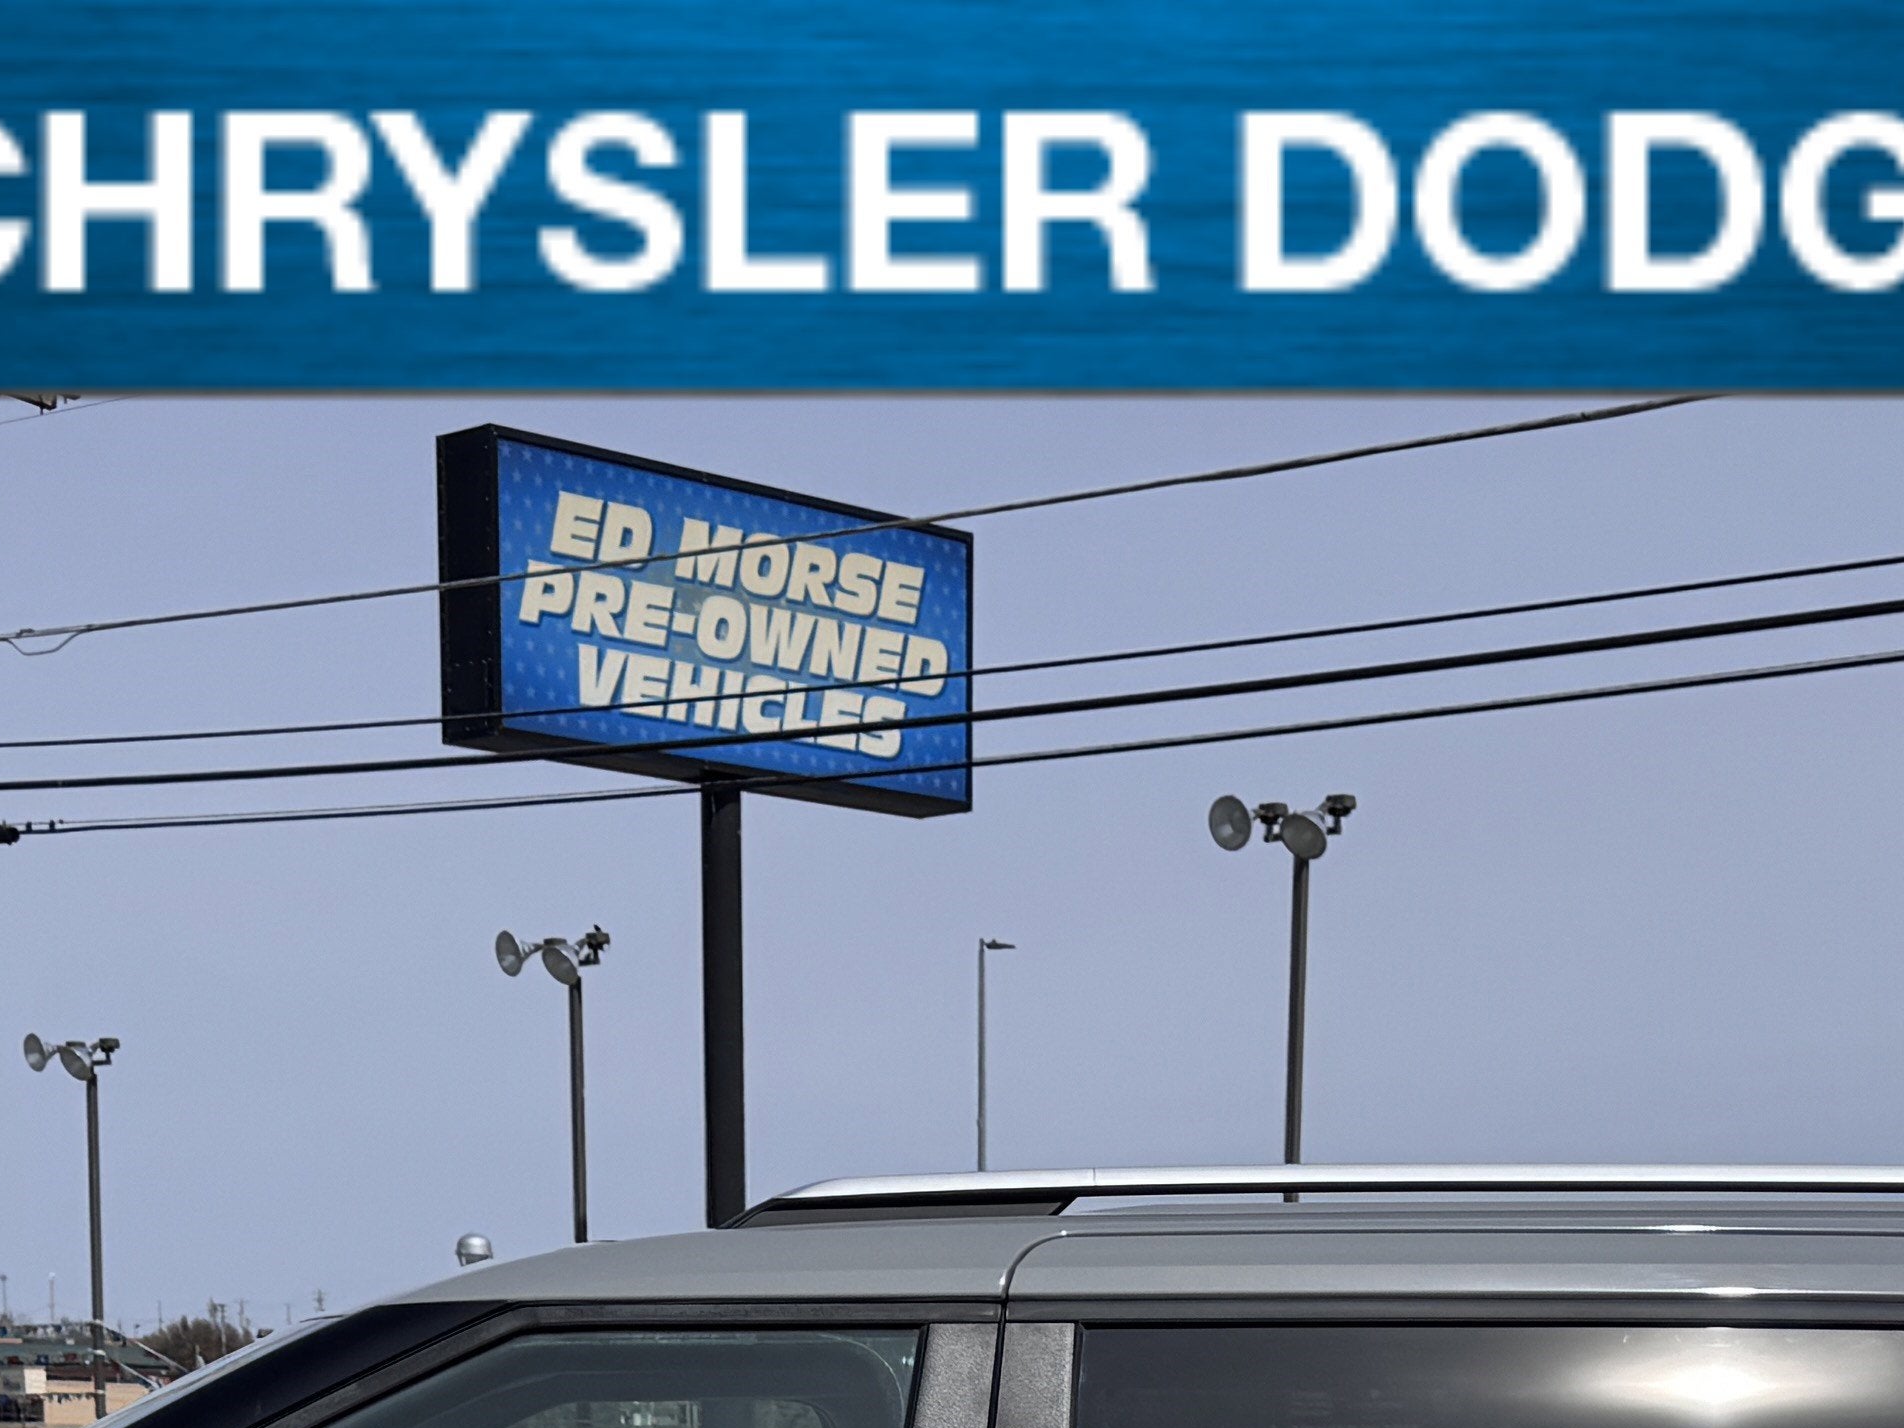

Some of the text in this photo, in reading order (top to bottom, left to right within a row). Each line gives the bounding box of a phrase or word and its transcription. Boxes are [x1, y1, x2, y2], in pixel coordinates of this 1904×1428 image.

[549, 490, 926, 626] ED MORSE
[518, 559, 950, 699] PRE-OWNED
[577, 643, 908, 760] VEHICLES
